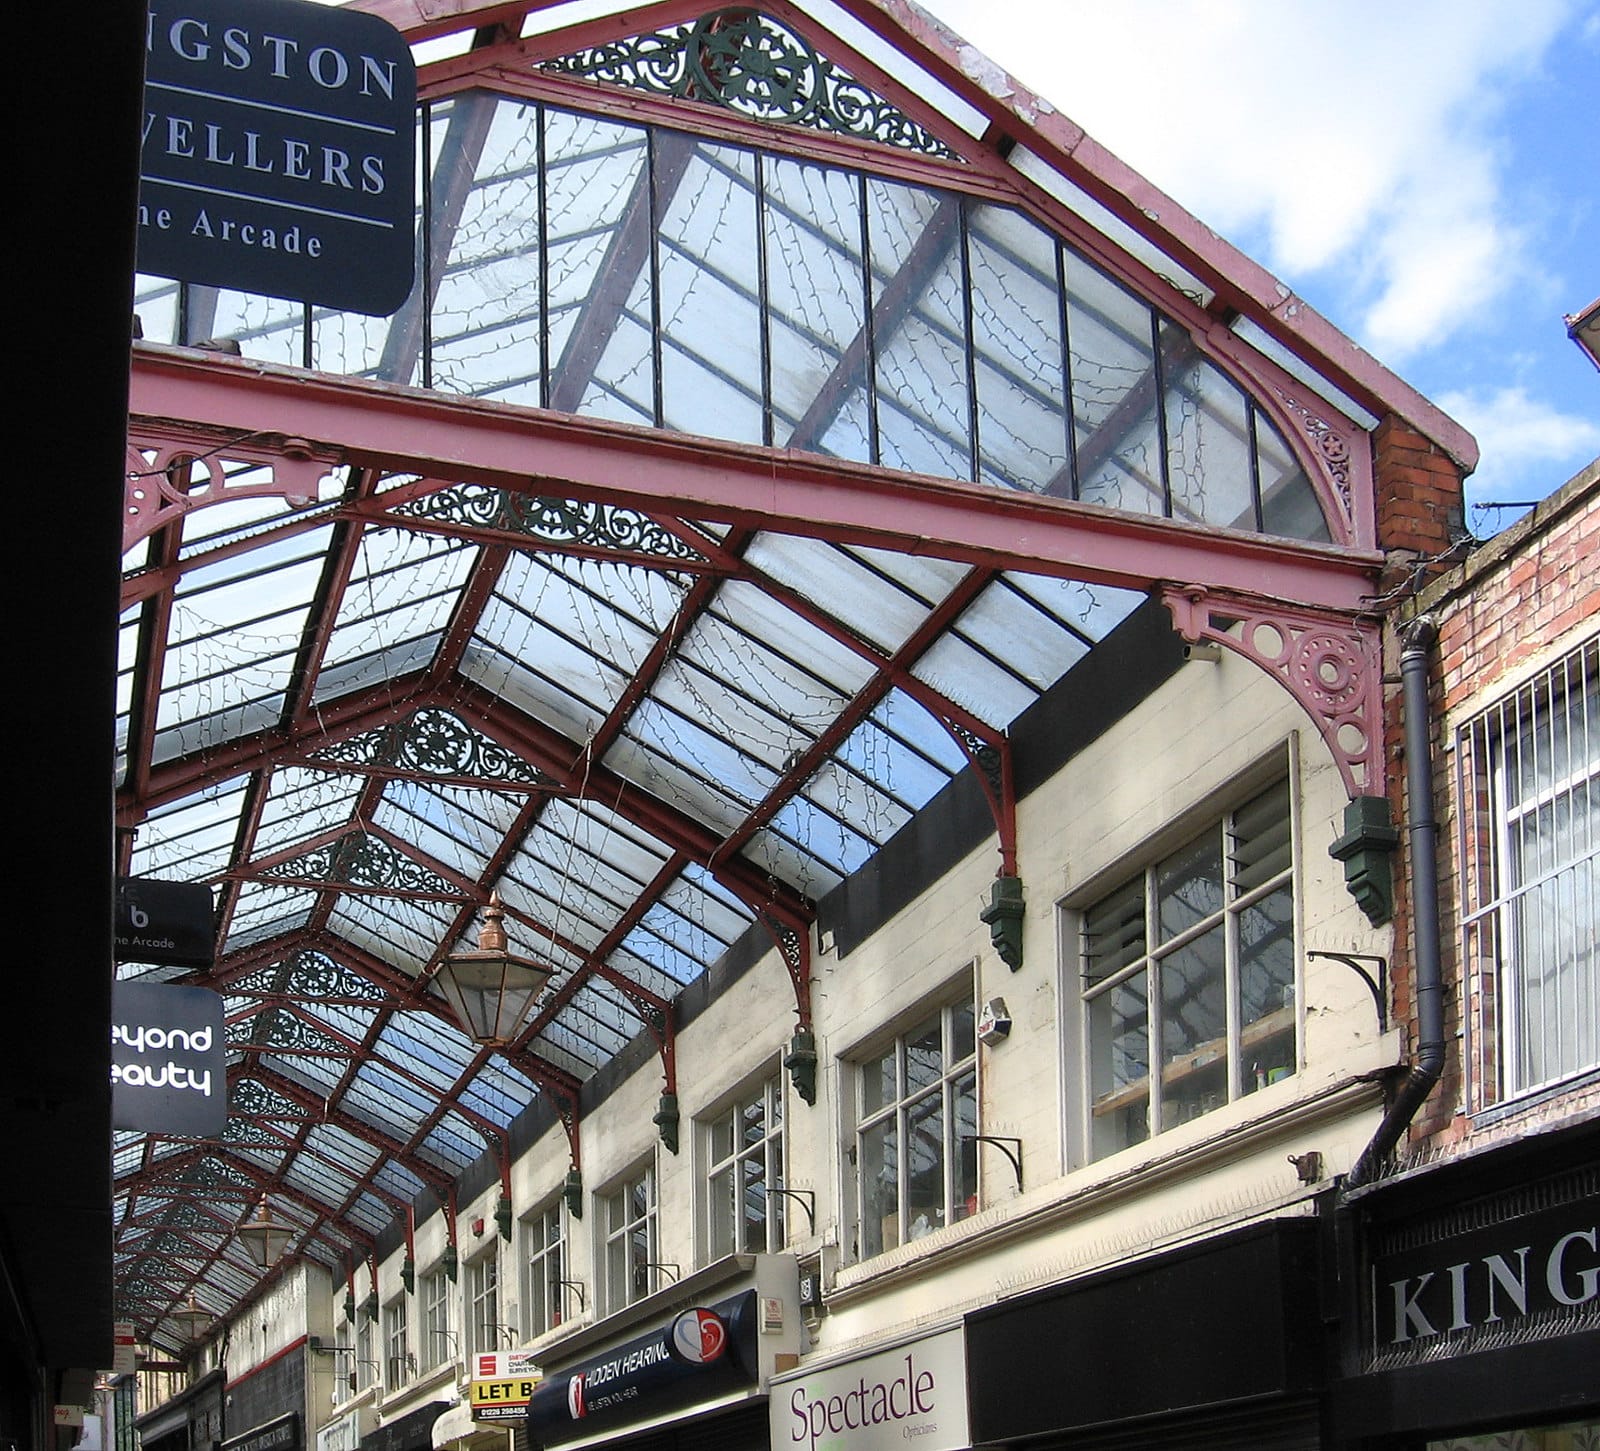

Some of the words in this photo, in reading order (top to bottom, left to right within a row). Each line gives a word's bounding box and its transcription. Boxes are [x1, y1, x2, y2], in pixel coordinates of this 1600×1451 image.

[191, 209, 322, 258] Arcade
[132, 935, 175, 949] Arcade
[1390, 1226, 1600, 1344] KING
[584, 1358, 622, 1390] HIDDEN
[622, 1340, 670, 1376] HEARING
[479, 1383, 514, 1400] LET
[521, 1381, 539, 1397] B
[791, 1354, 935, 1451] Spectacle
